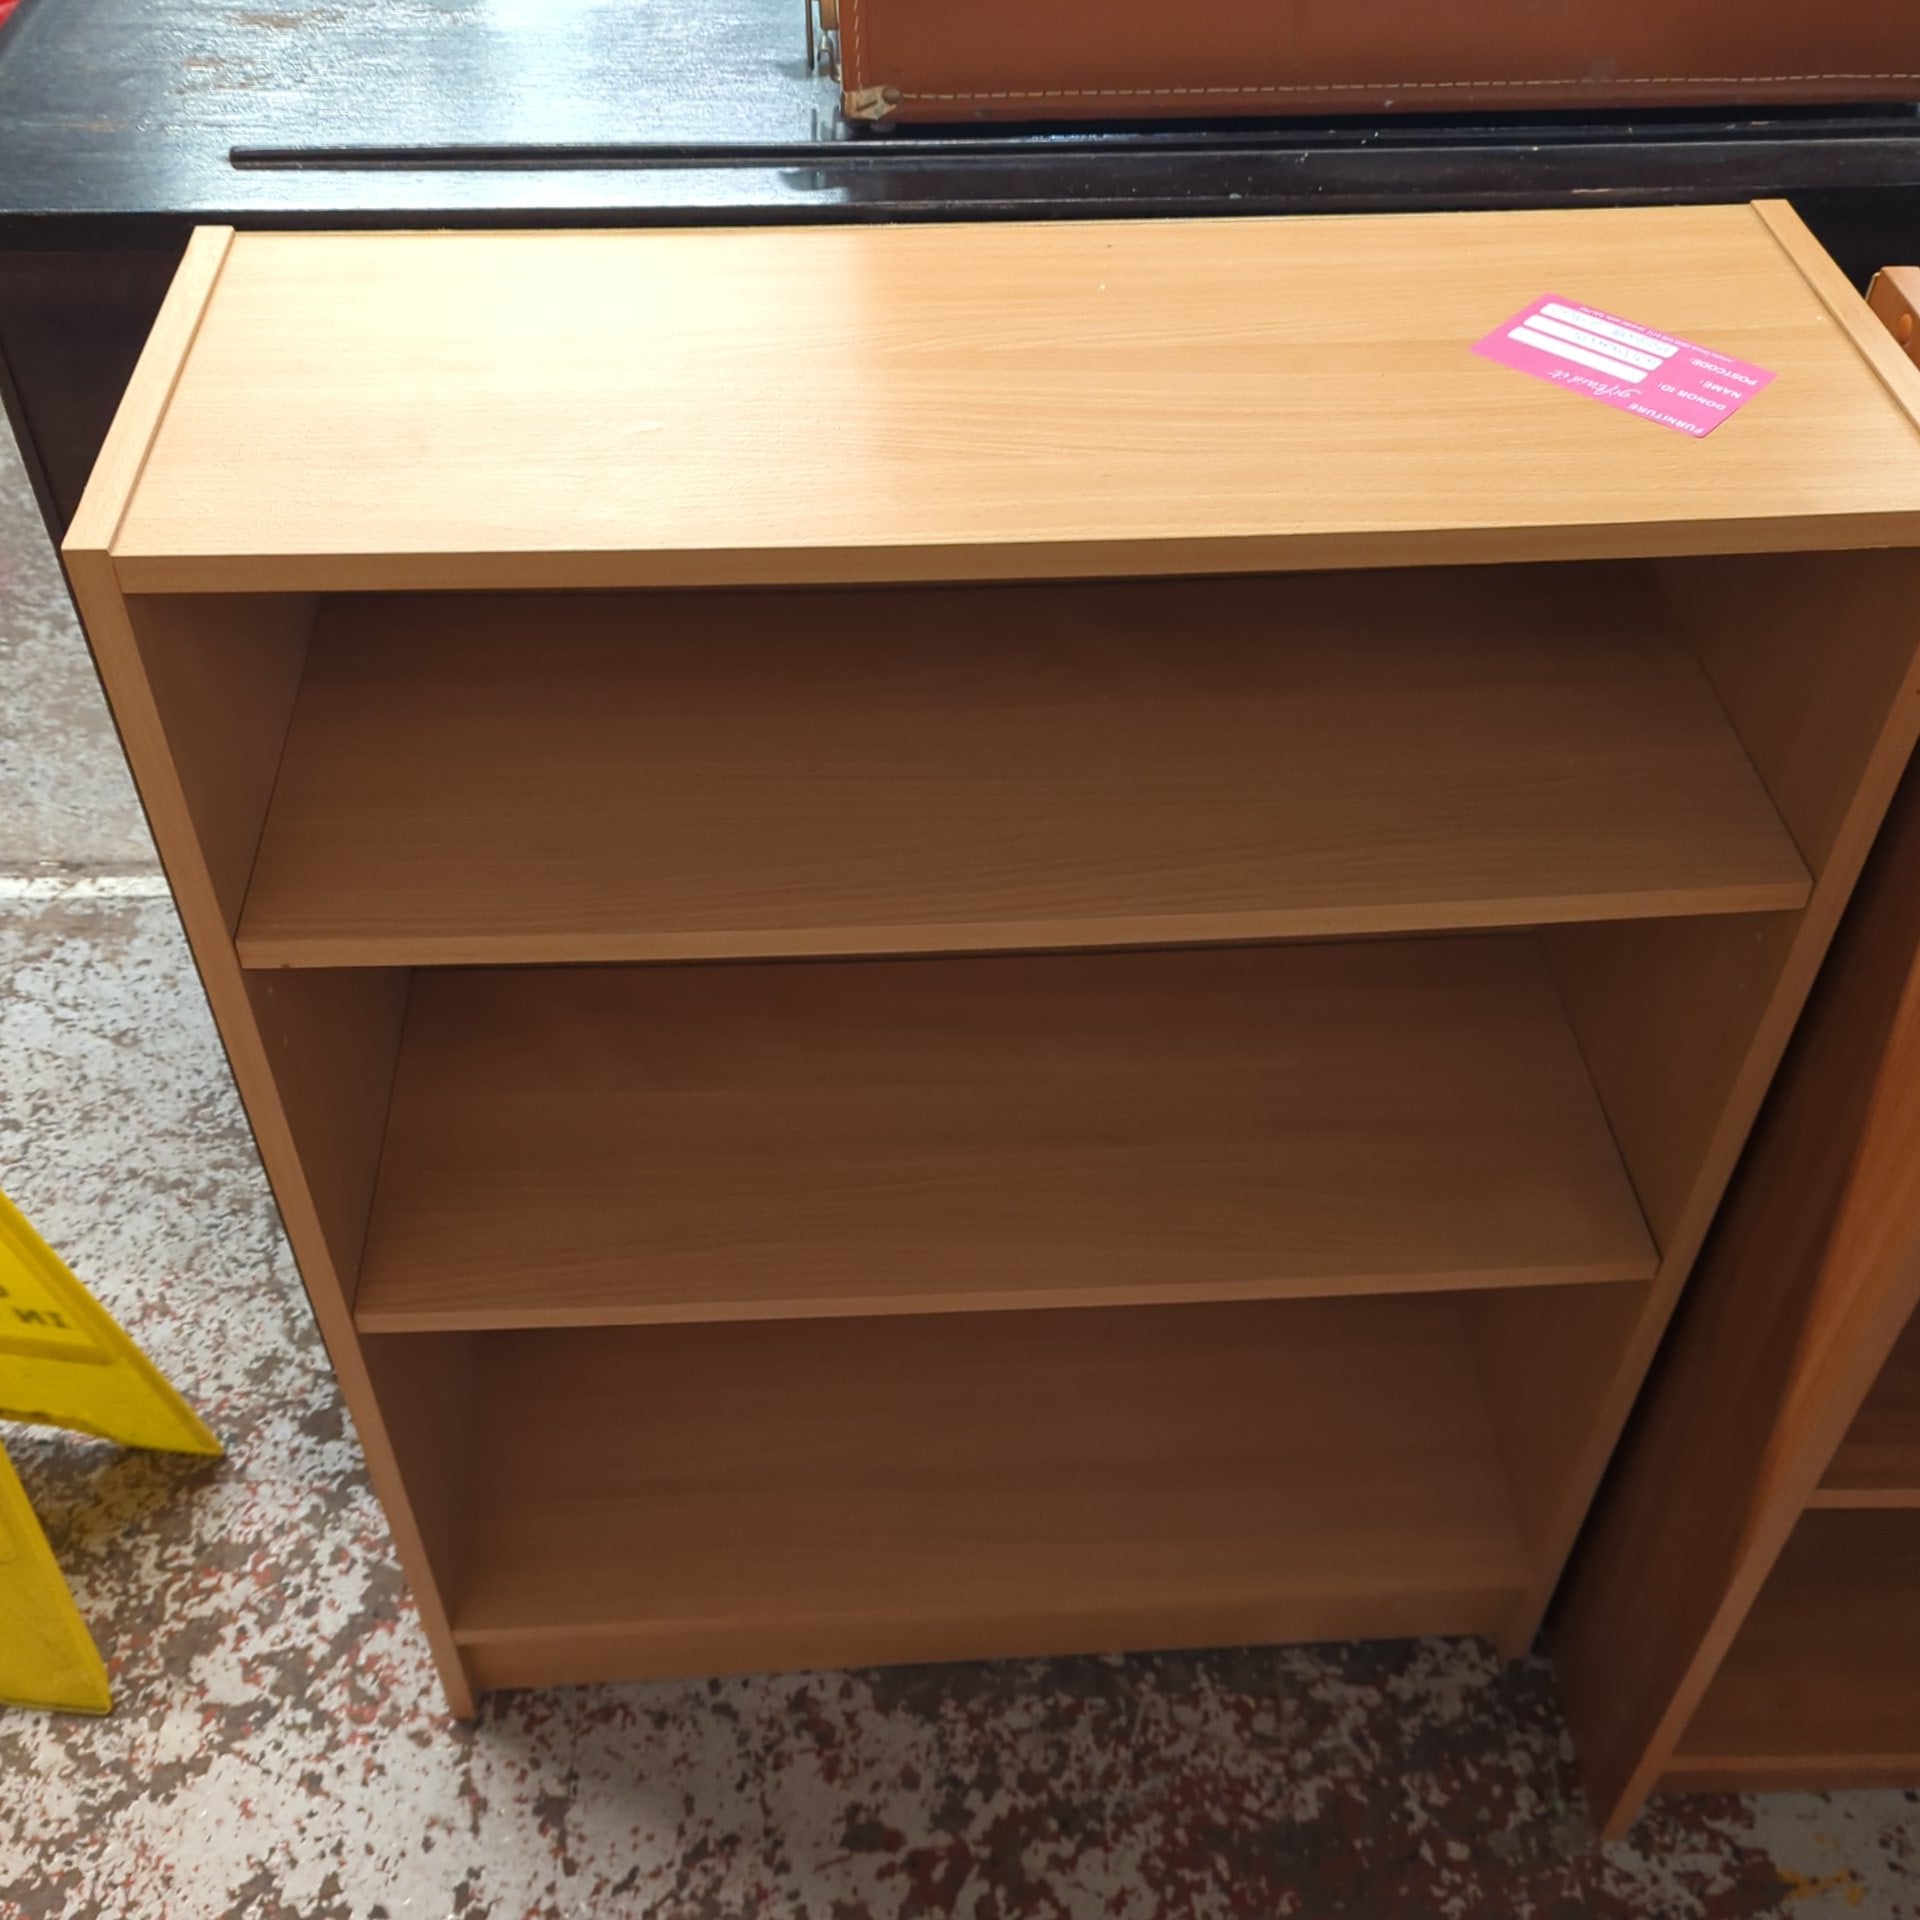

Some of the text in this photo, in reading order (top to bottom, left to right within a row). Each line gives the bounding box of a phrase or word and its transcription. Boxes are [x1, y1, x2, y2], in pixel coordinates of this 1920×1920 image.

[1689, 357, 1758, 386] POSTCODE:
[1657, 381, 1726, 412] DONOR ID:
[1699, 379, 1743, 399] NAME:
[1627, 402, 1705, 434] FURNITURE
